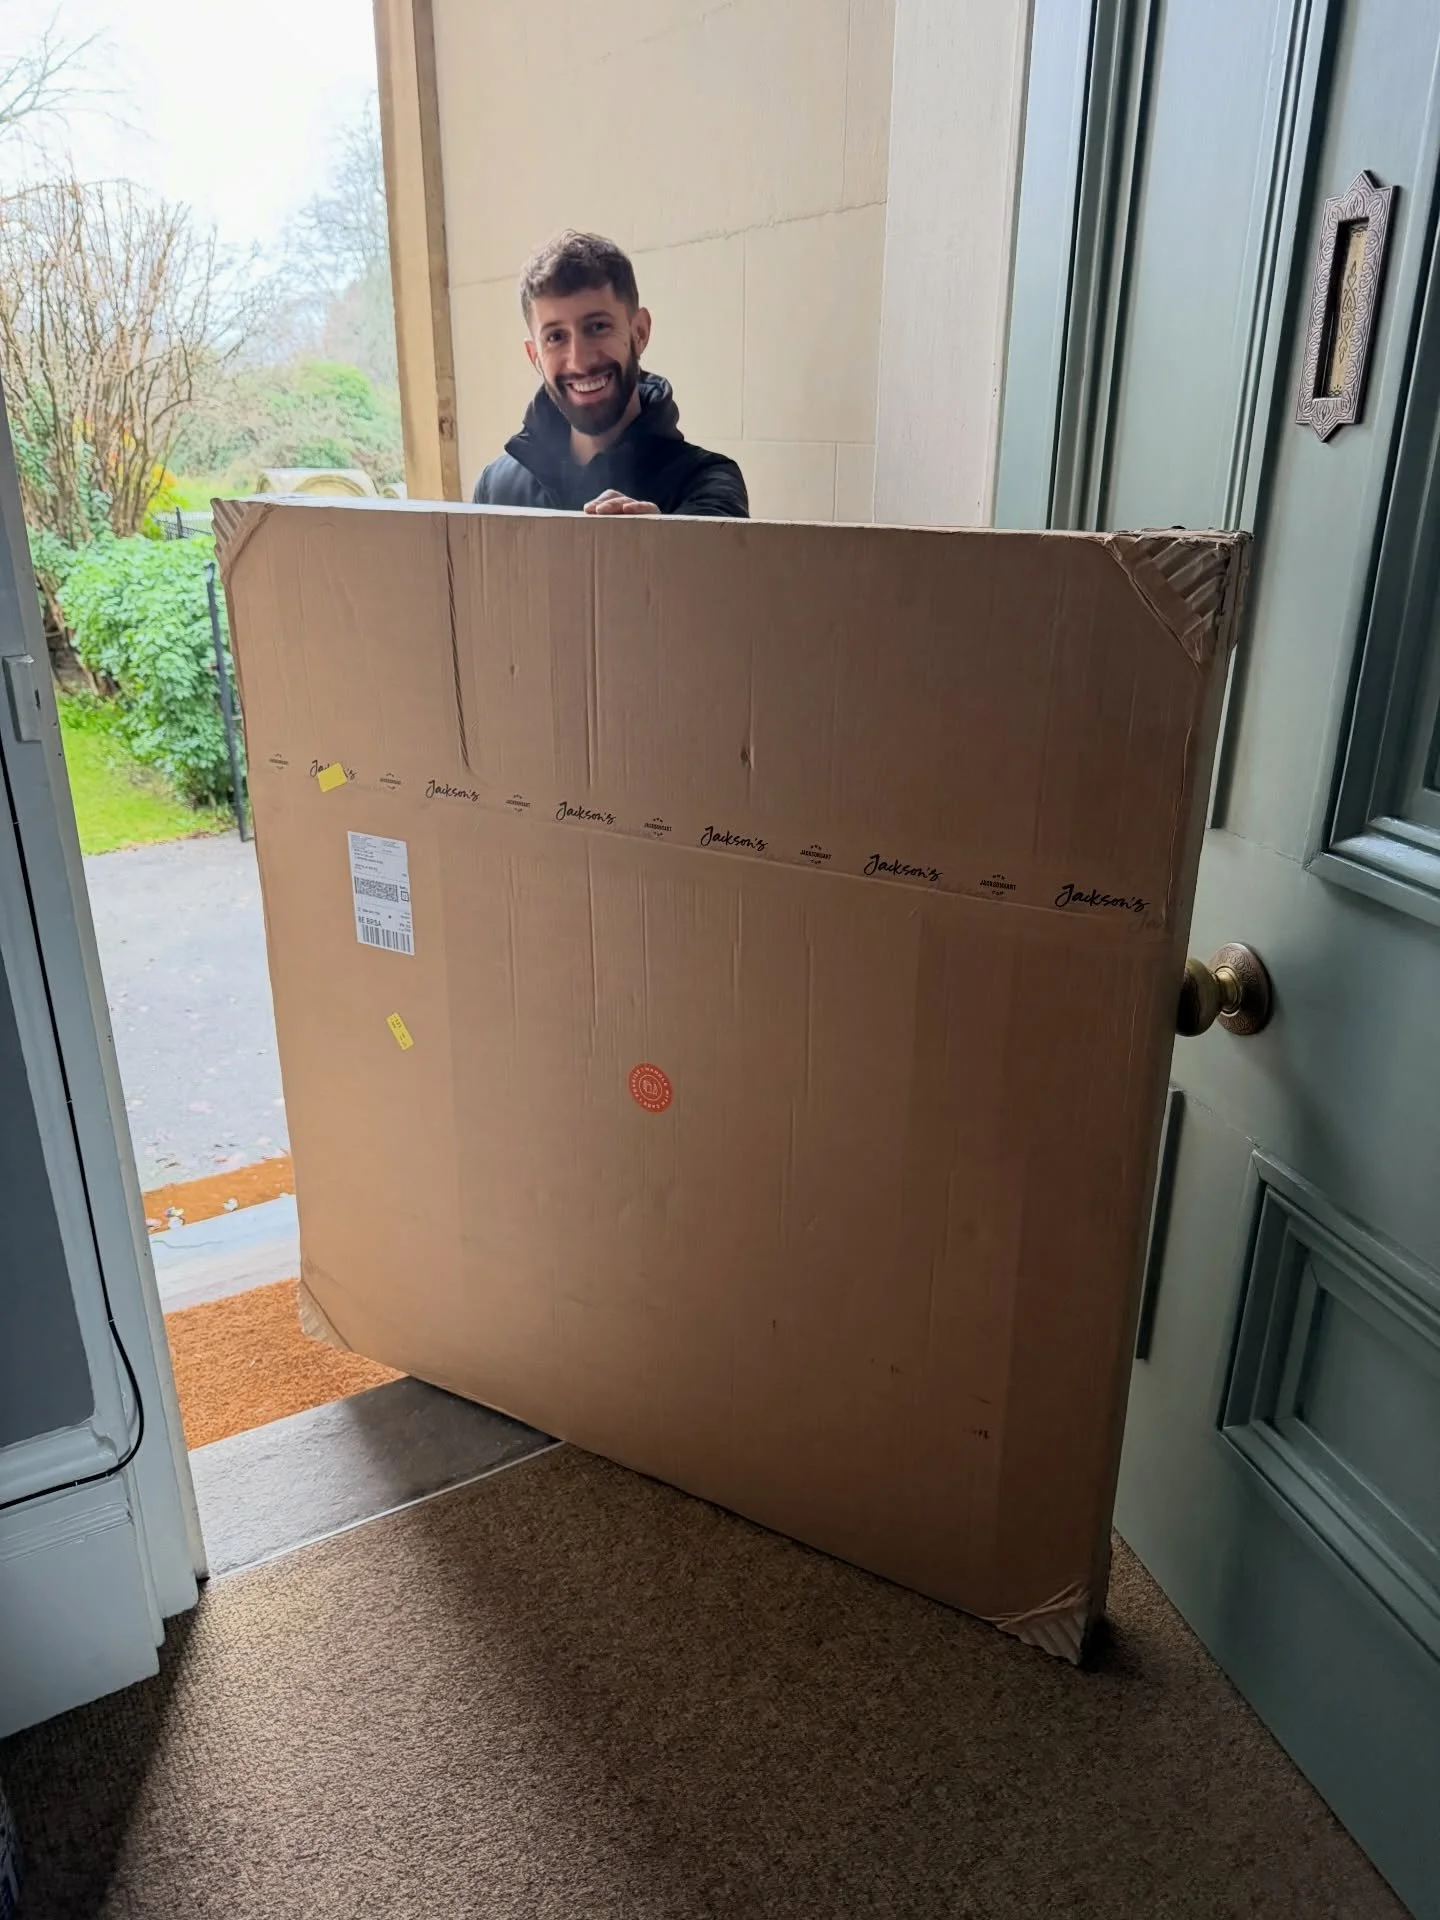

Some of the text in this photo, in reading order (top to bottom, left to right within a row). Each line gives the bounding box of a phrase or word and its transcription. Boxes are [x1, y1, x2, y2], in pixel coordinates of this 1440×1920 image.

[425, 779, 480, 802] Jackson's
[555, 801, 616, 825] Jackson's
[700, 825, 769, 852] Jackson's
[863, 853, 943, 881] Jackson's
[1054, 883, 1150, 912] Jackson's
